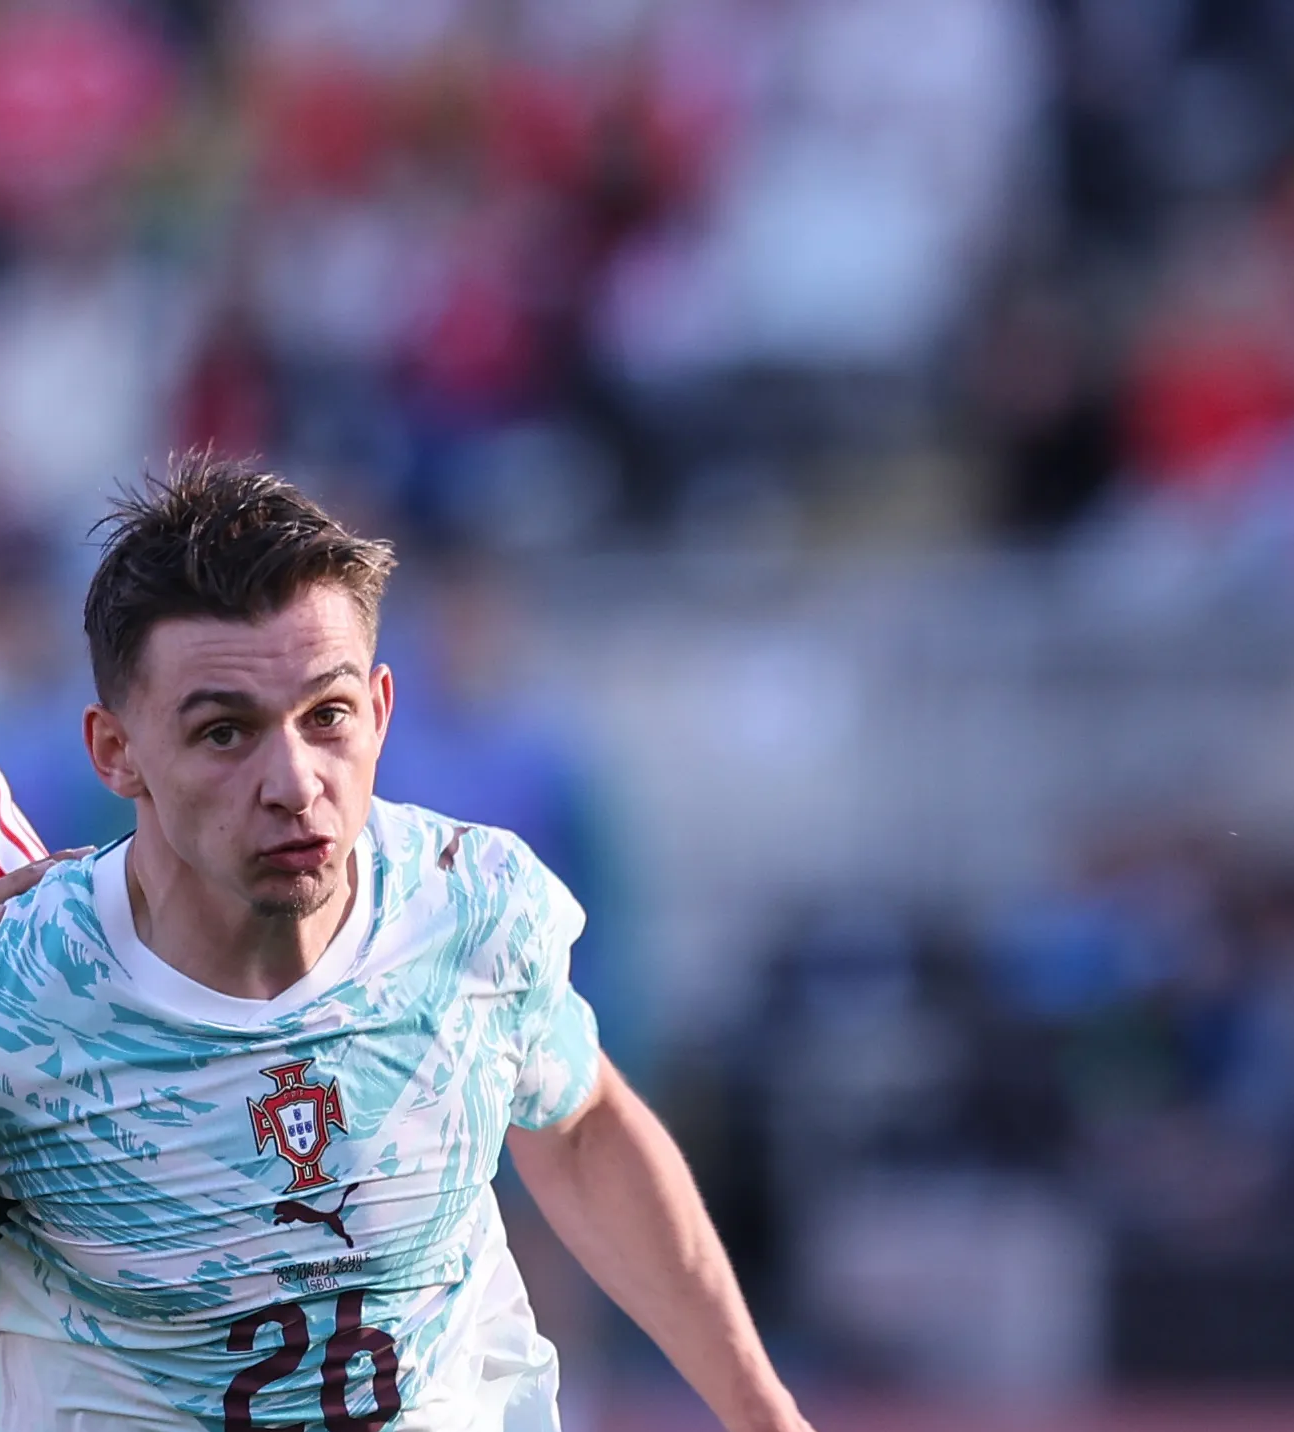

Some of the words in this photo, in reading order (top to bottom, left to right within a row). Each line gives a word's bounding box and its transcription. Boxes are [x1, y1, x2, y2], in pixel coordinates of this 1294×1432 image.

[294, 1267, 330, 1282] JUNHO
[334, 1264, 363, 1275] 2026
[300, 1277, 340, 1294] LISBOA
